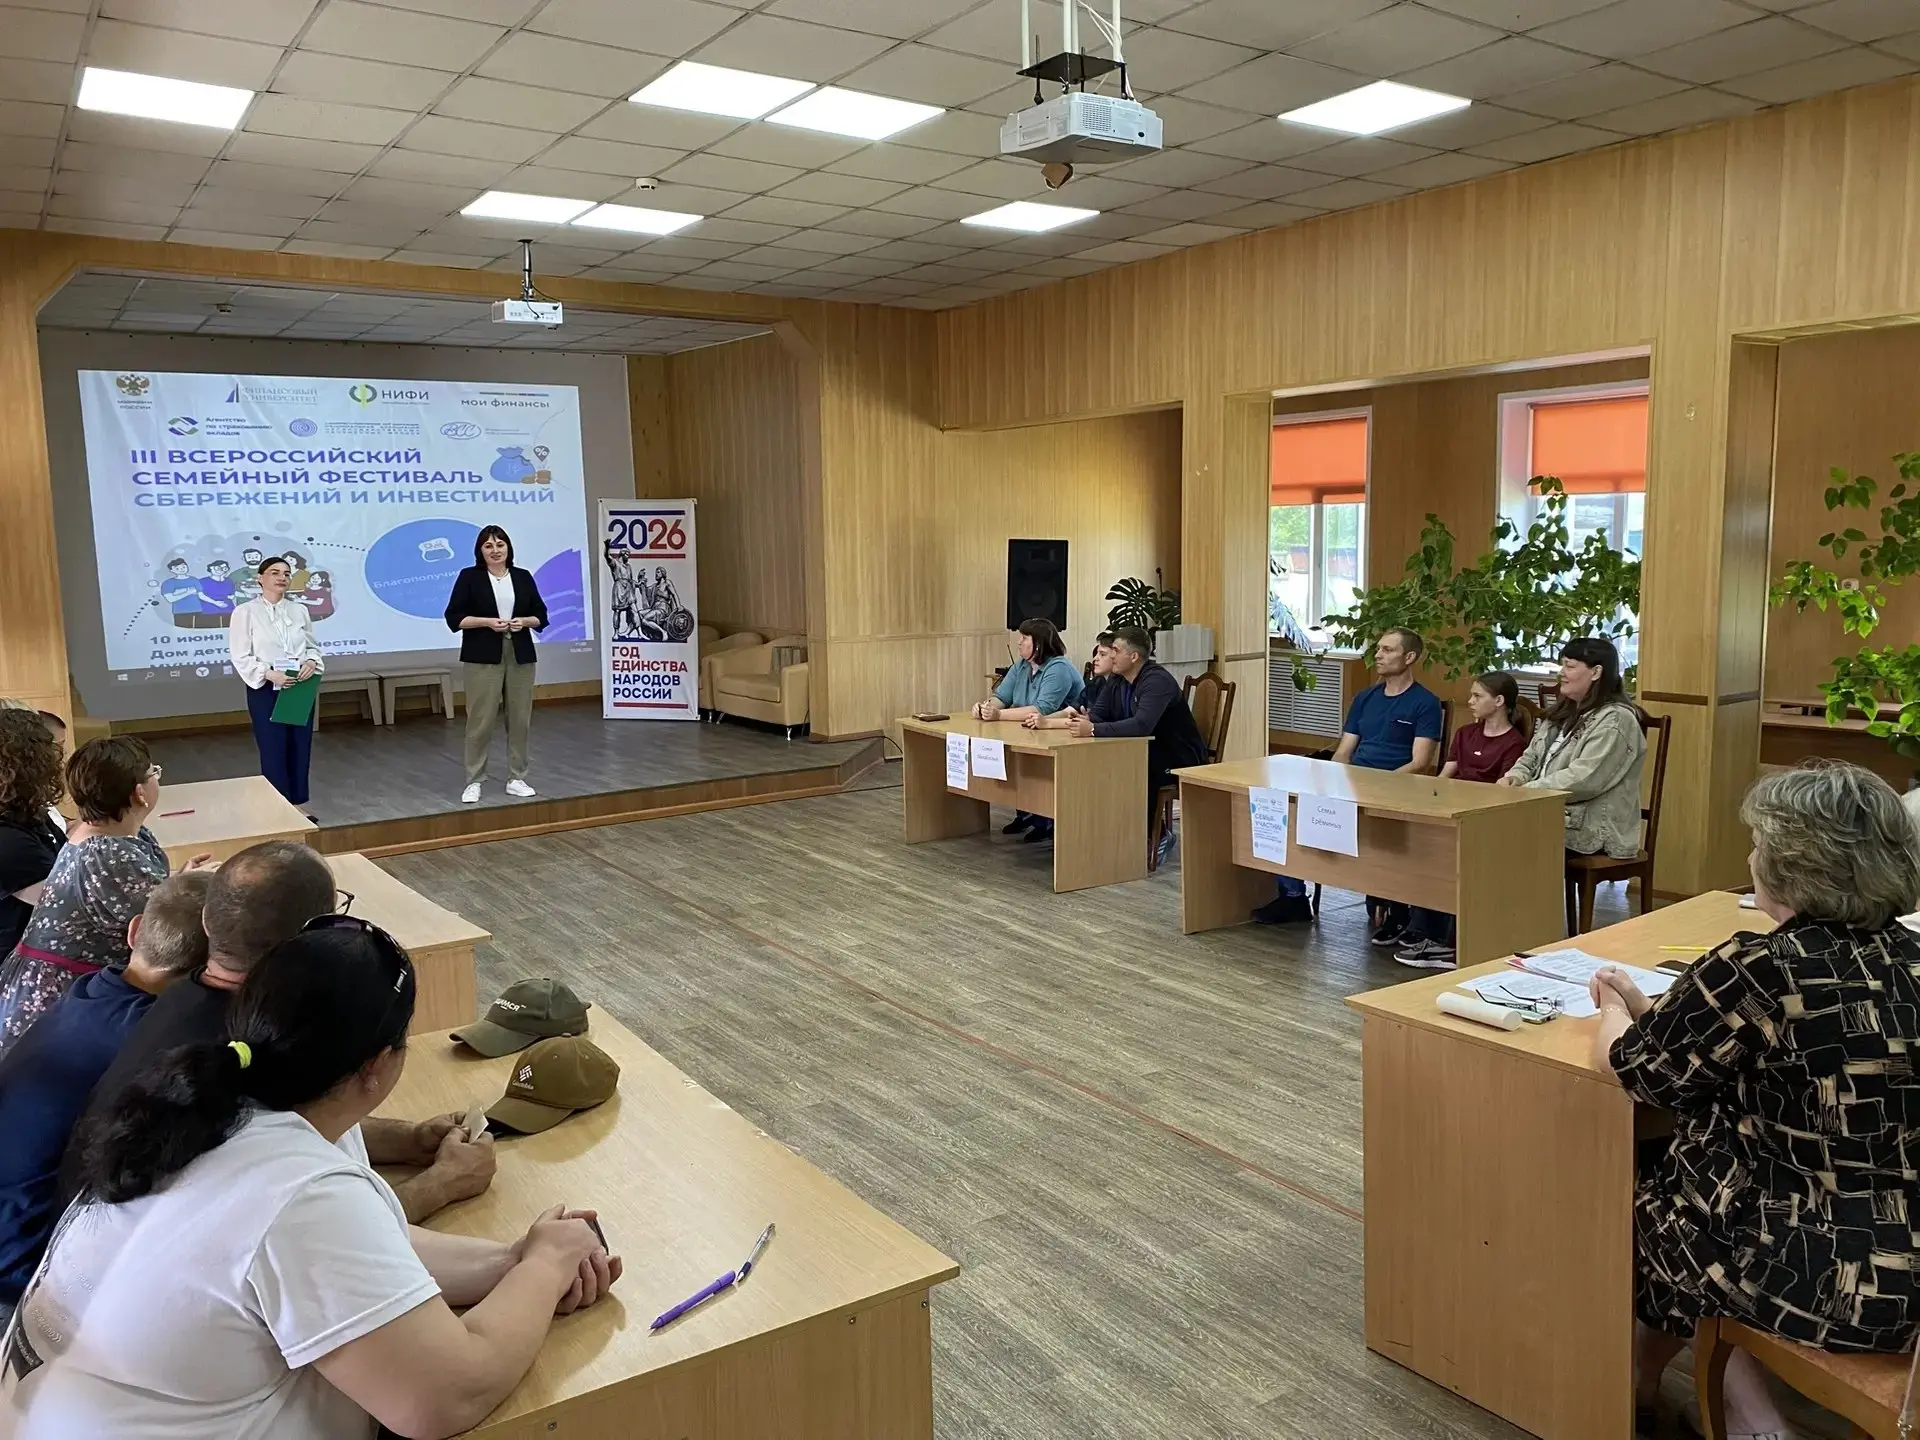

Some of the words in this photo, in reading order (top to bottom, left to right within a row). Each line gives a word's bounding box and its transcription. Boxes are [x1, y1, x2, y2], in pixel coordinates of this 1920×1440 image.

[381, 390, 429, 400] НИФИ
[491, 398, 550, 408] финансы
[168, 448, 421, 464] ВСЕРОССИЙСКИЙ
[132, 469, 309, 485] СЕМЕЙНЫЙ
[318, 470, 483, 484] ФЕСТИВАЛЬ
[133, 489, 341, 507] СБЕРЕЖЕНИЙ
[351, 491, 368, 504] И
[378, 488, 554, 505] ИНВЕСТИЦИЙ
[608, 518, 686, 550] 2026
[150, 635, 171, 645] 10
[176, 634, 224, 643] июня
[150, 649, 189, 660] Дом
[611, 646, 640, 659] ГОД
[612, 660, 688, 672] ЕДИНСТВА
[612, 674, 681, 687] НАРОДОВ
[613, 688, 672, 699] РОССИИ
